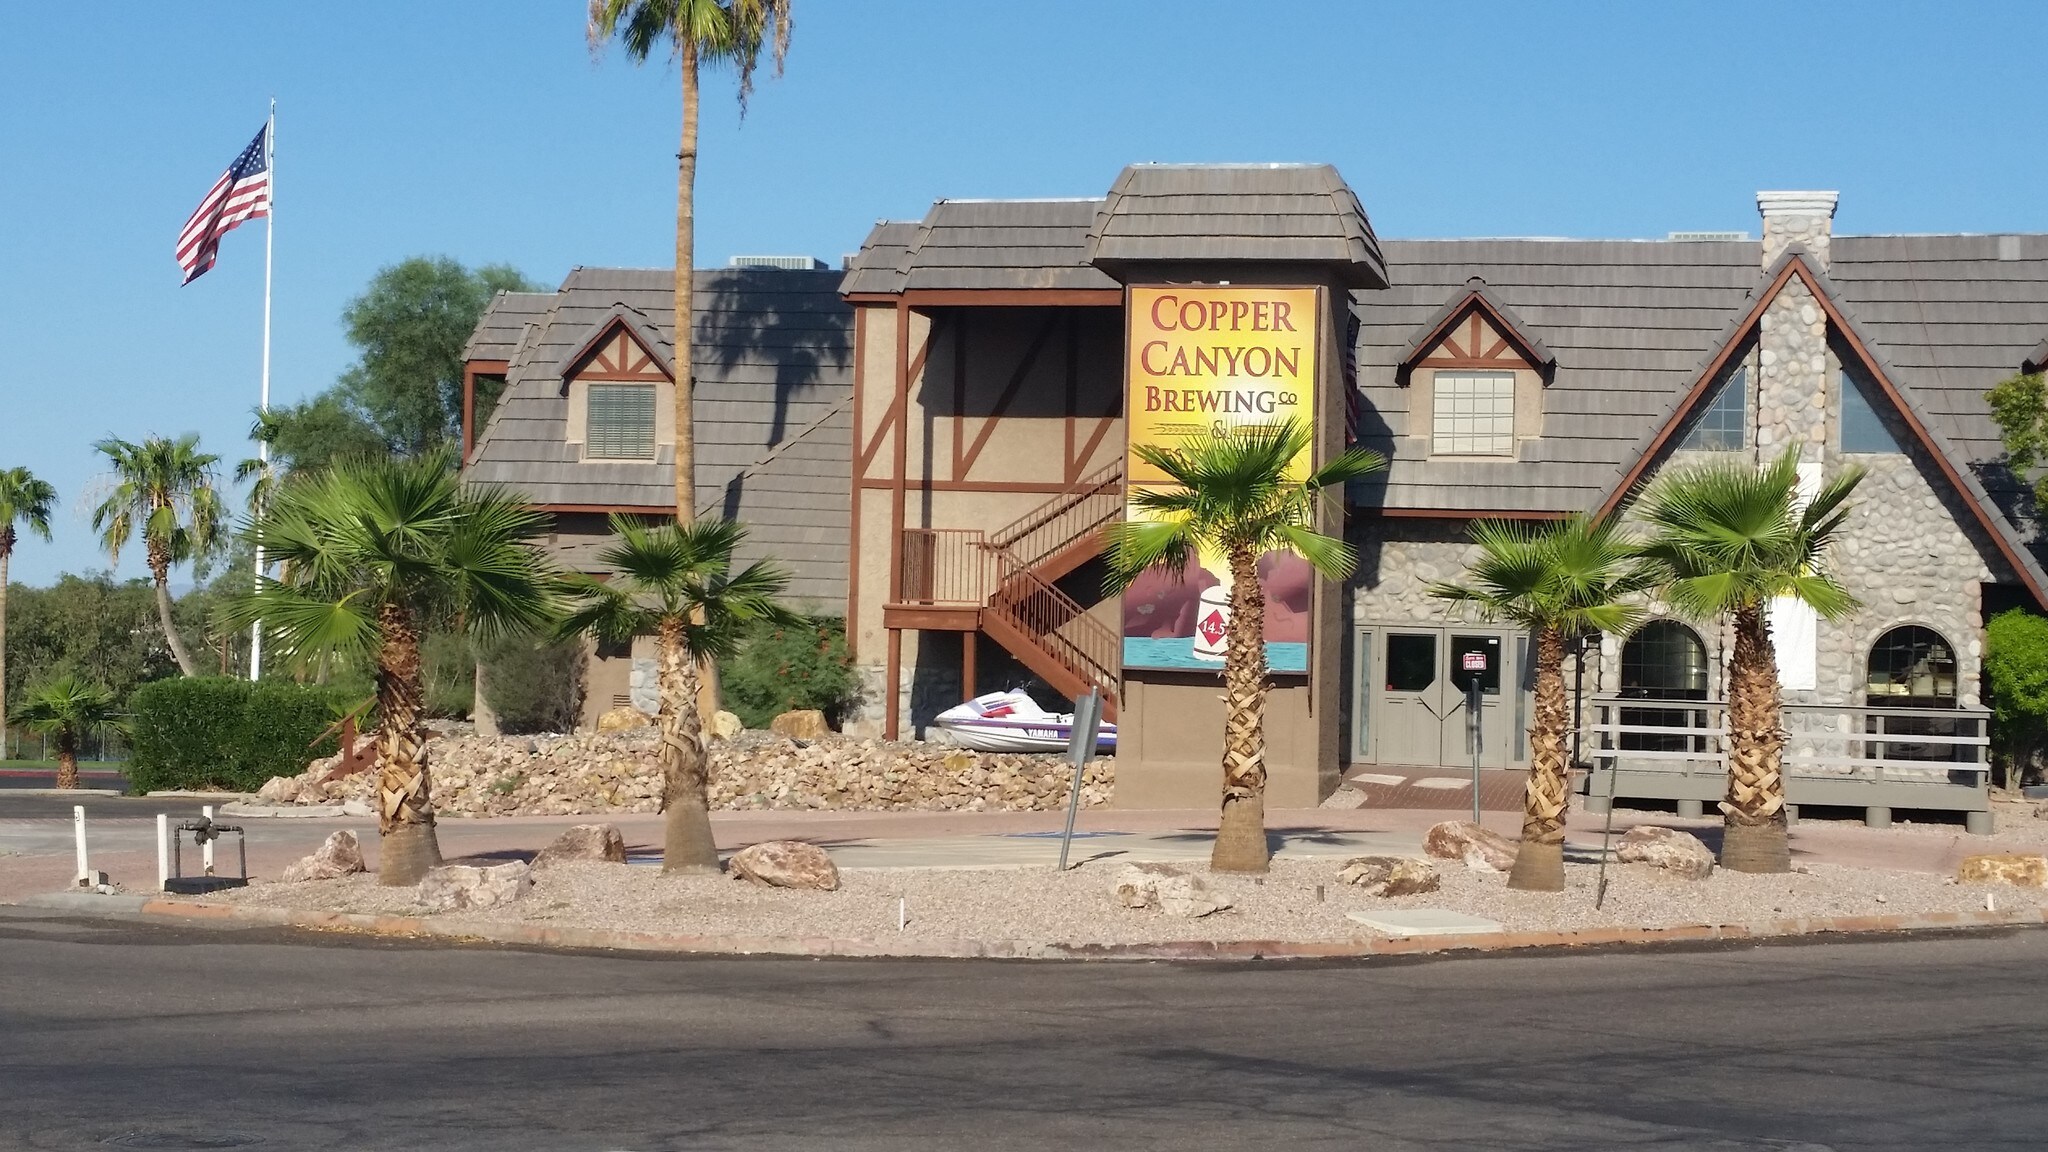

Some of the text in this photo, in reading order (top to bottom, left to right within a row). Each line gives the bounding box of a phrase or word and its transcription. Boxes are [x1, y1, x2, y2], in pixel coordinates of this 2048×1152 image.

[1151, 295, 1297, 332] COPPER
[1141, 341, 1300, 377] CANYON
[1145, 386, 1276, 413] BREWING
[1212, 419, 1228, 440] &
[1202, 621, 1226, 635] 14.5
[1028, 728, 1058, 738] YAMAHA
